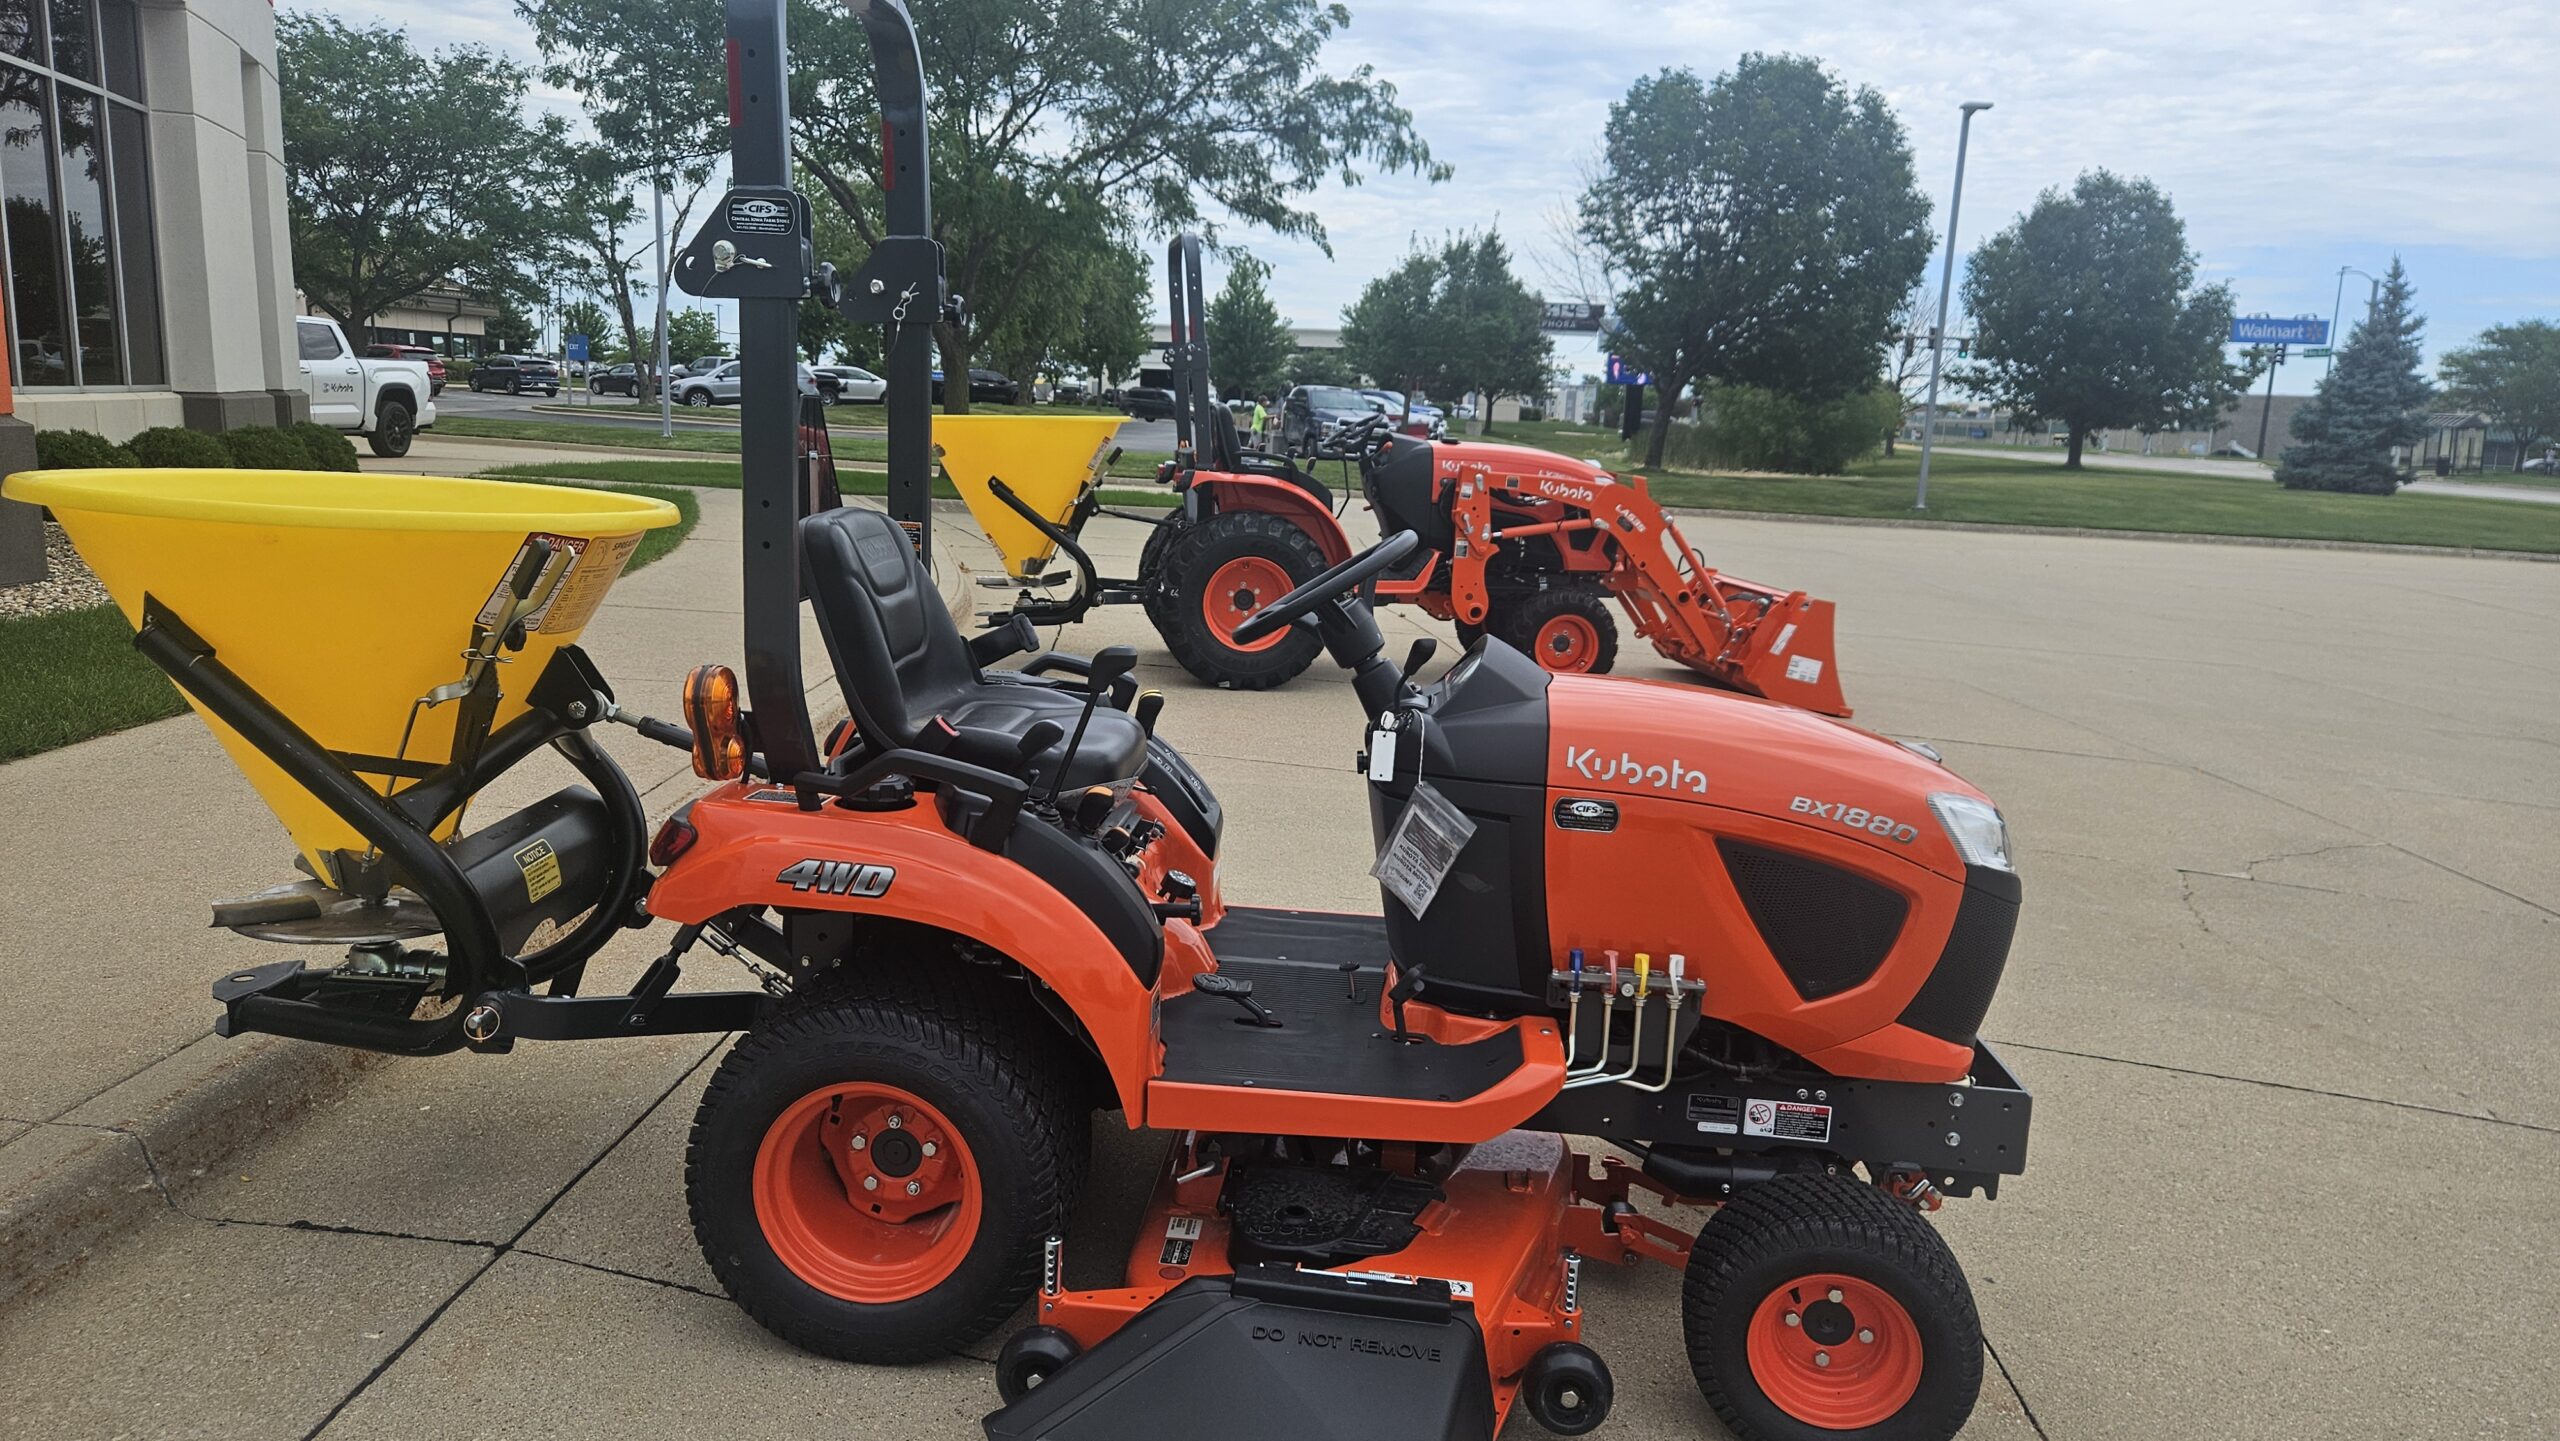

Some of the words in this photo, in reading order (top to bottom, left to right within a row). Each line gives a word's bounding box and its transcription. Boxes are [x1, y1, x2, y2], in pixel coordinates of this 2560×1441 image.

[748, 204, 772, 214] CIFS
[2239, 322, 2304, 339] Walmart
[1539, 480, 1594, 502] Kubota
[1566, 746, 1708, 794] Kubota
[1575, 804, 1600, 815] CIFS
[1789, 795, 1919, 845] BX1880
[522, 845, 546, 864] NOTICE
[776, 858, 897, 898] 4WD
[1786, 1105, 1816, 1113] DANGER
[1252, 1326, 1286, 1342] DO
[1298, 1330, 1343, 1349] NOT
[1349, 1336, 1441, 1363] REMOVE
